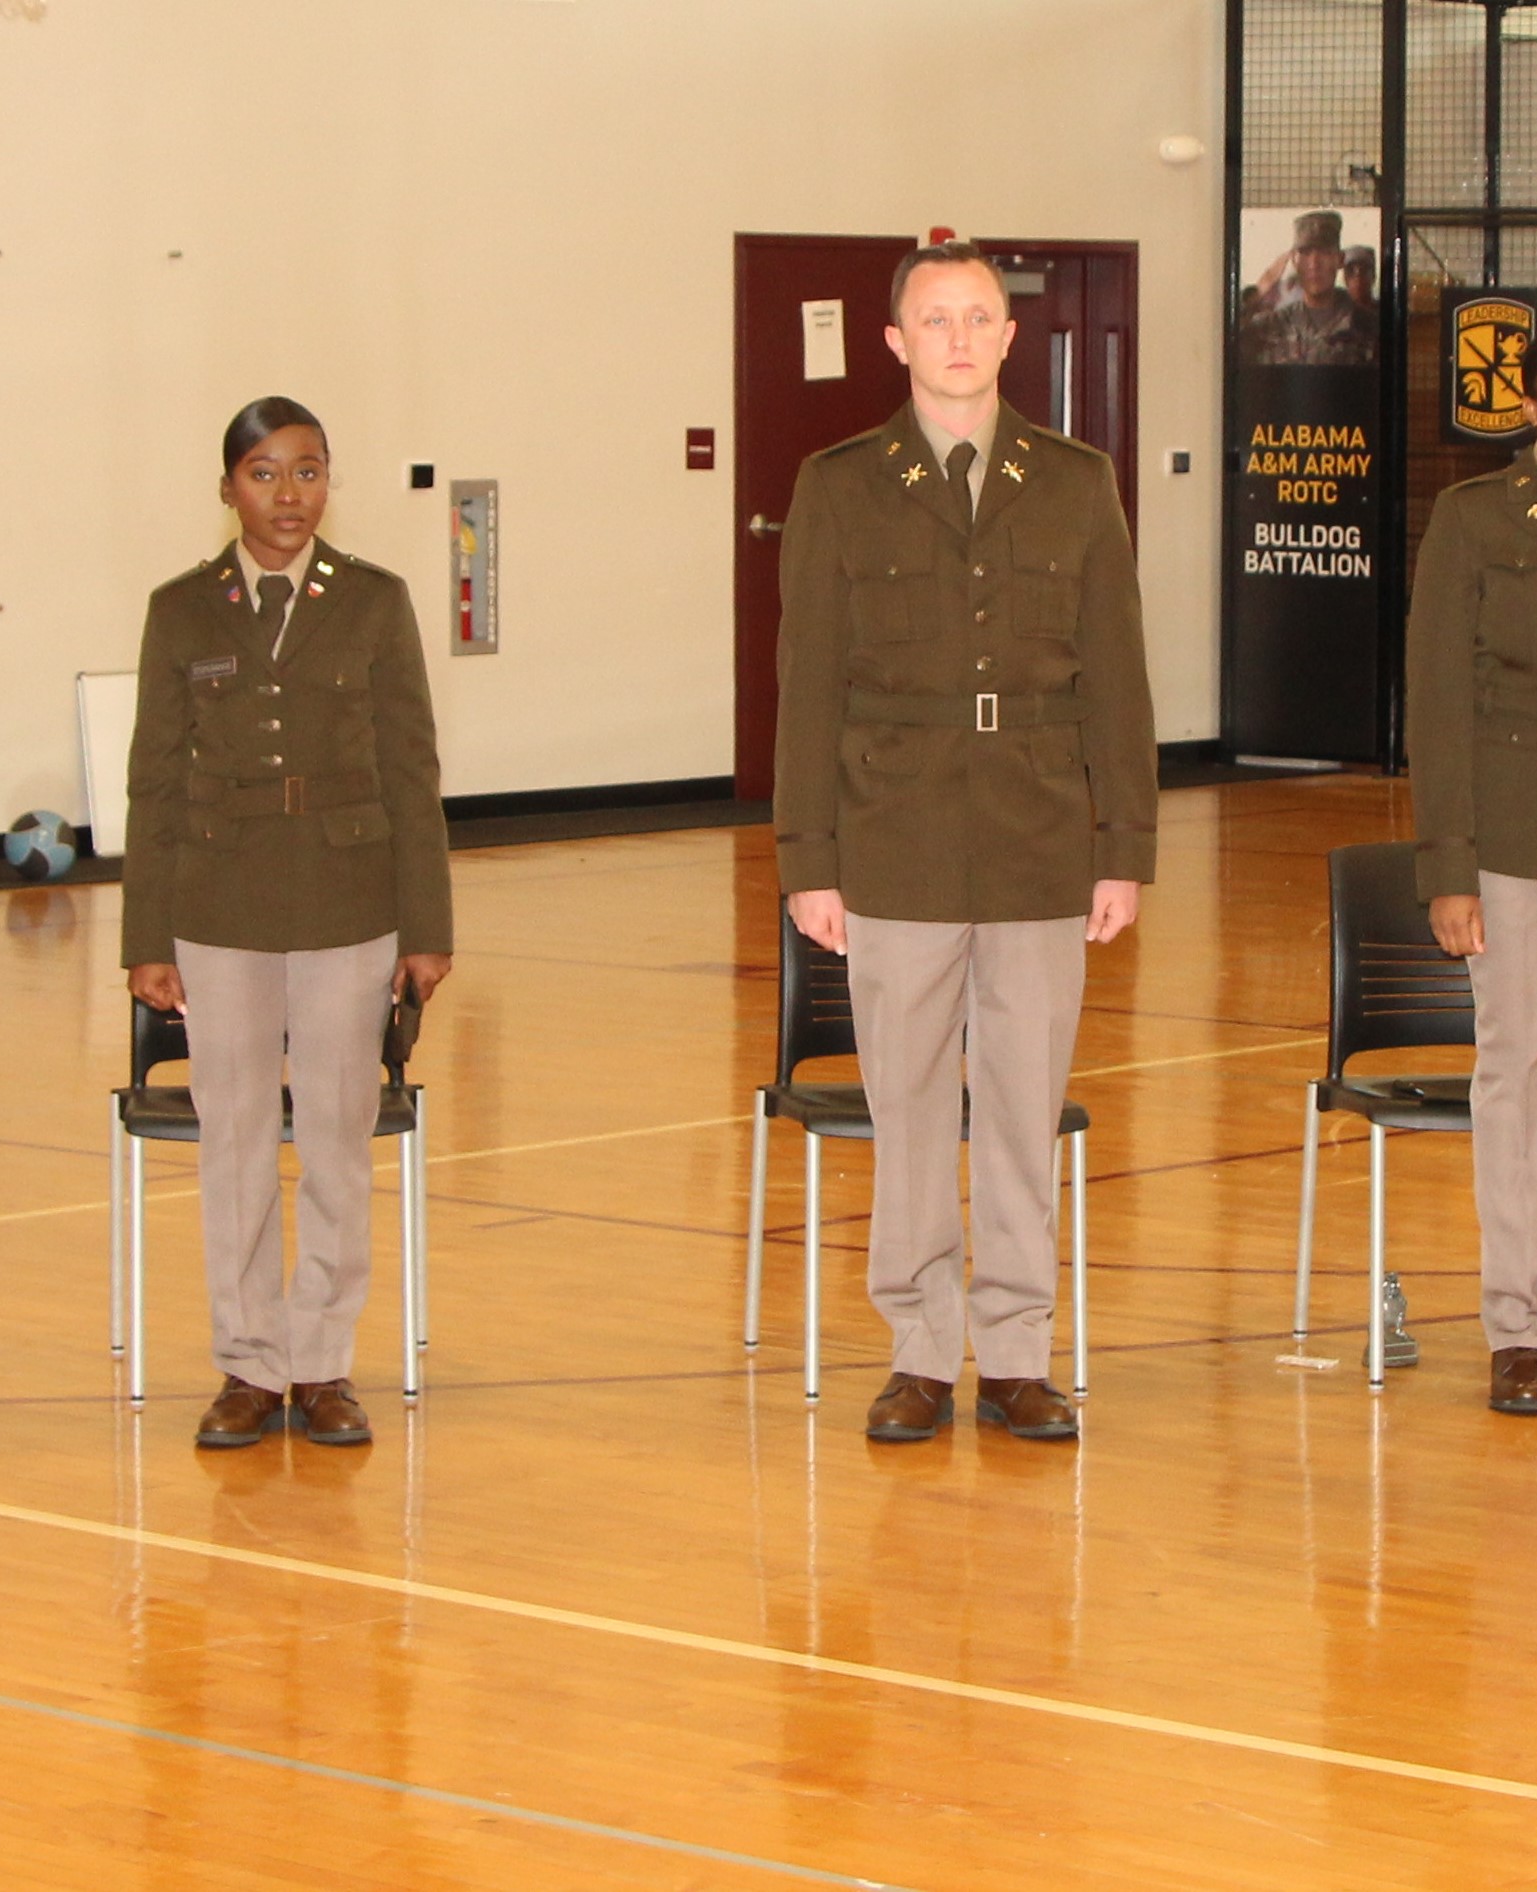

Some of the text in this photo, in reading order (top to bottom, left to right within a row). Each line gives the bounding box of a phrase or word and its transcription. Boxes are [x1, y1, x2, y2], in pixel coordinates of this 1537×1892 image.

[1460, 304, 1528, 327] LEADERSHIP
[1251, 424, 1366, 448] ALABAMA
[1246, 452, 1371, 477] A&M ARMY
[1278, 480, 1338, 504] ROTC
[1255, 523, 1361, 549] BULLDOG
[1245, 550, 1371, 578] BATTALION
